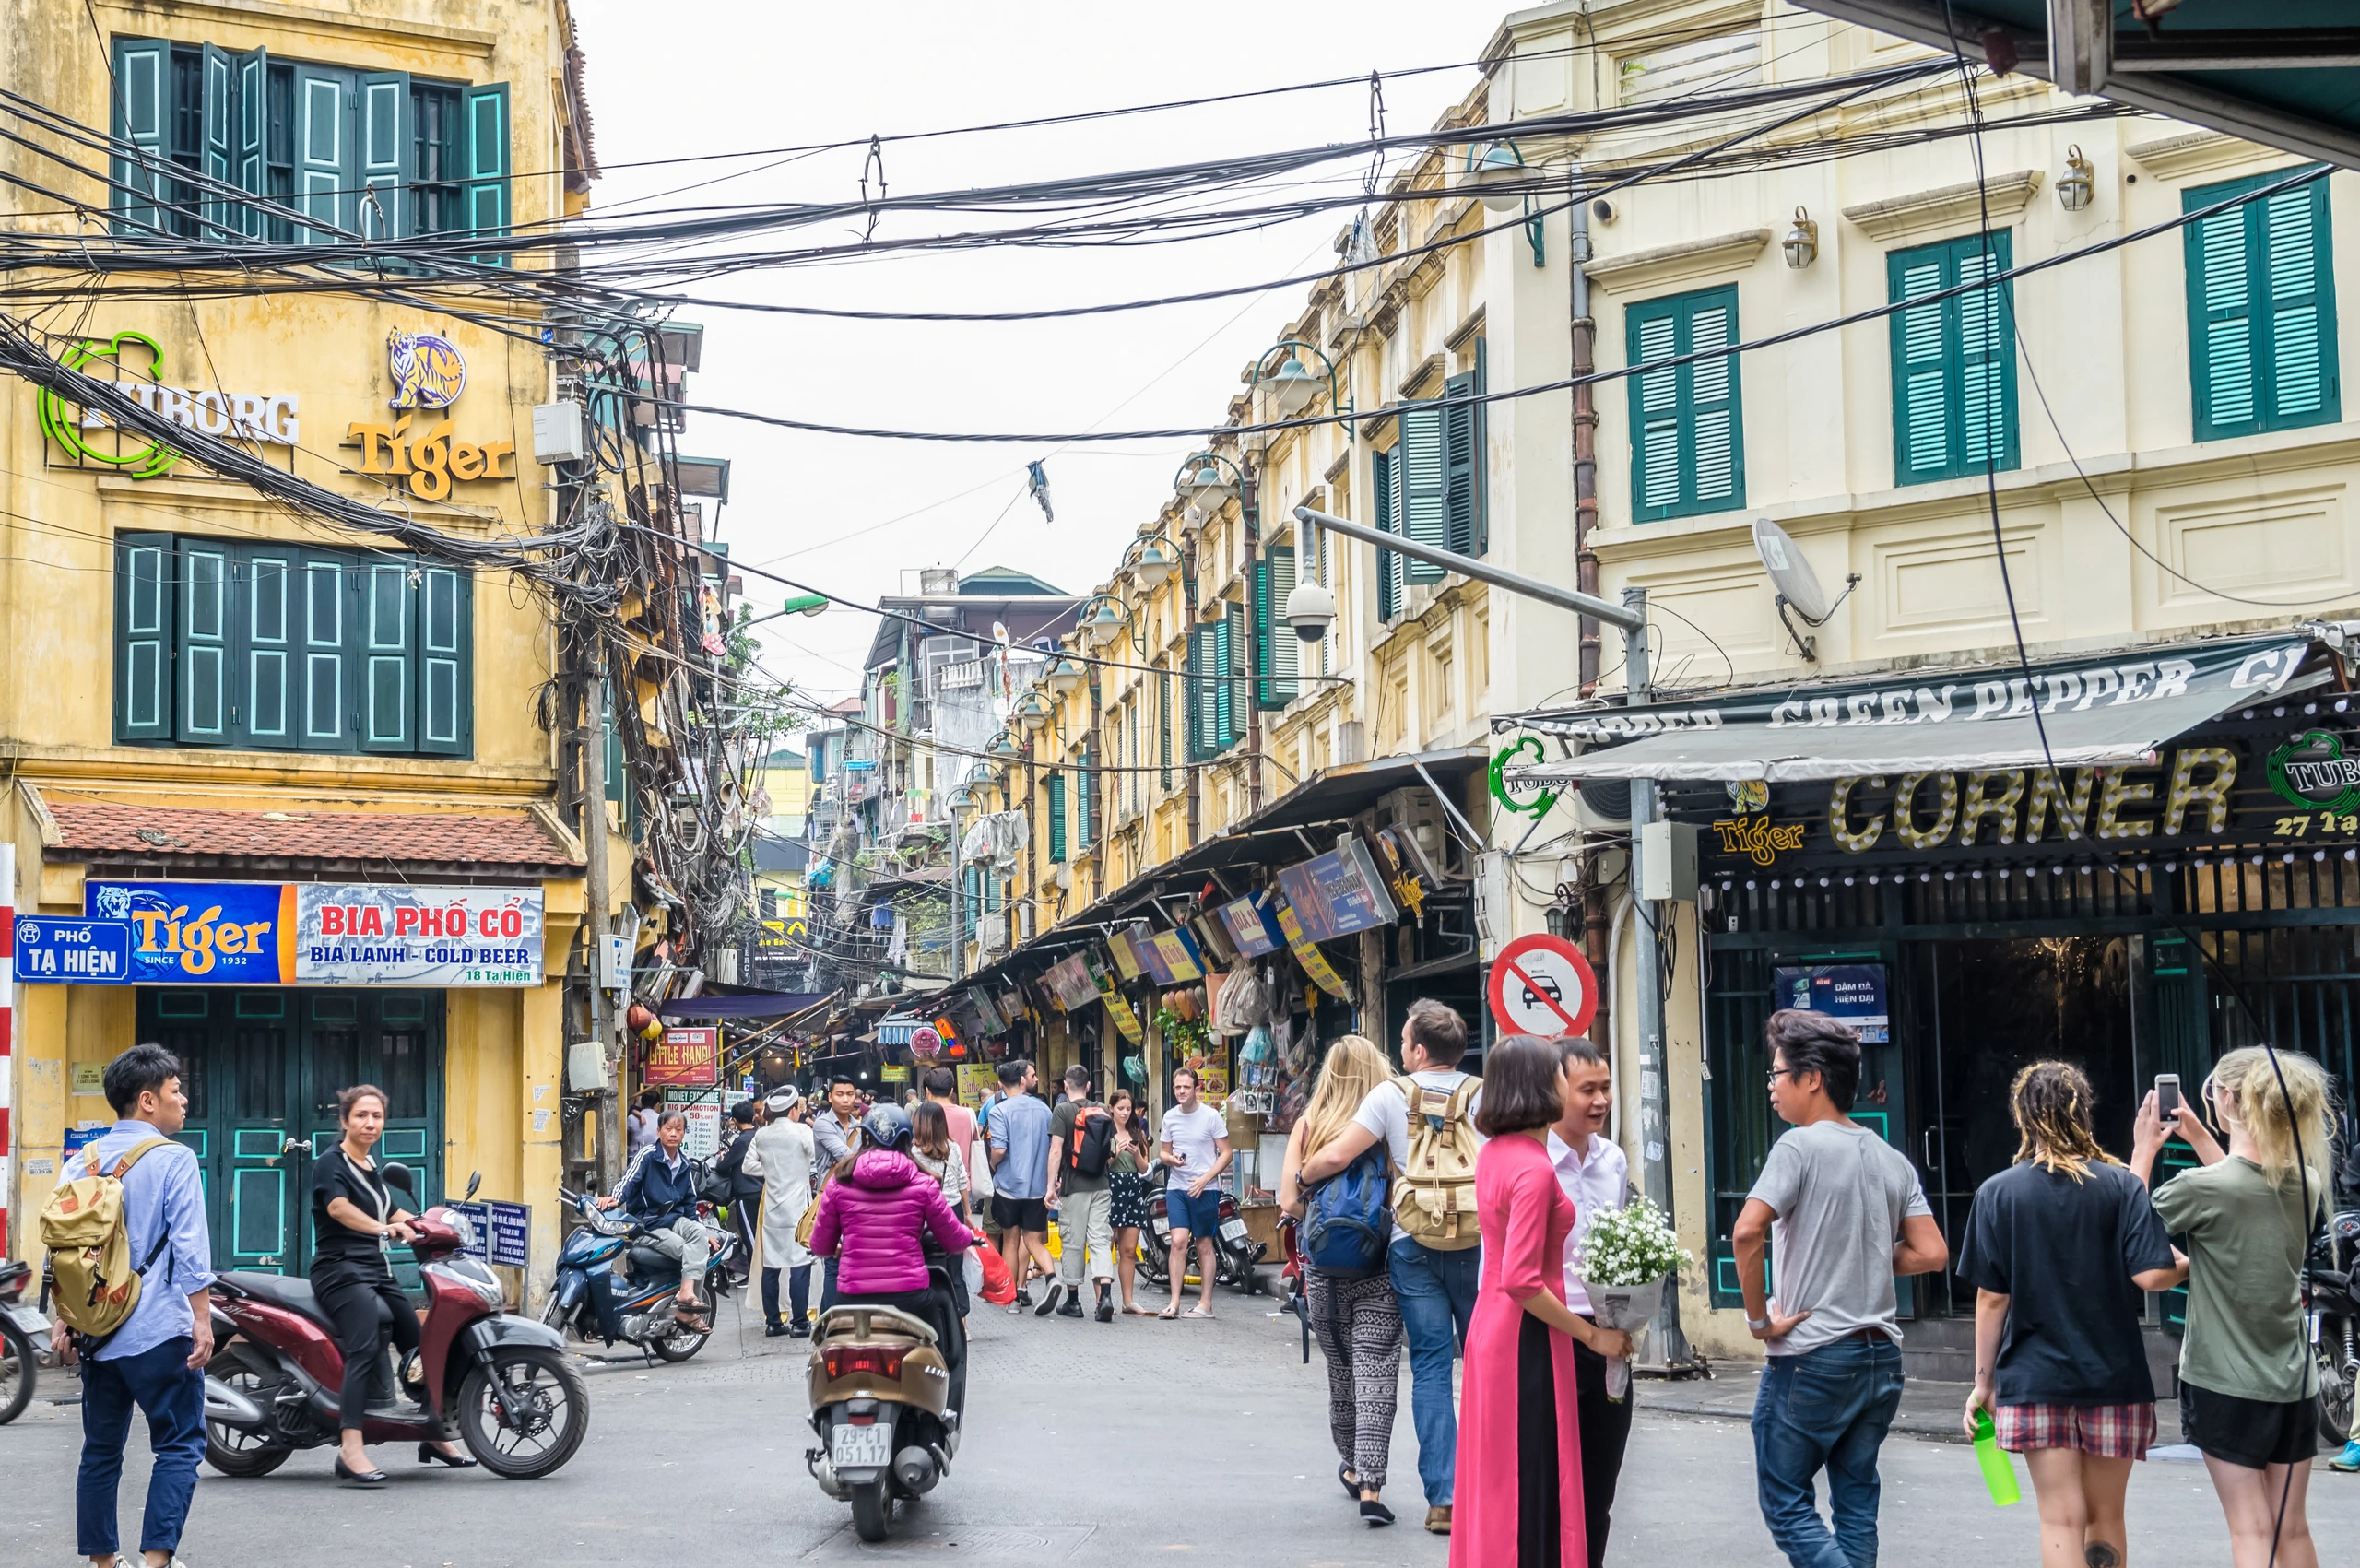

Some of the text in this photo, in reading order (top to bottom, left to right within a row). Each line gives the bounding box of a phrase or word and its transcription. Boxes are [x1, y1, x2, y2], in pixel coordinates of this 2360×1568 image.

[347, 414, 513, 501] Tiger
[1765, 685, 1957, 728] GREEN
[1964, 659, 2196, 721] PEPPER
[1829, 748, 2237, 855] CORNER
[2273, 816, 2311, 837] 27
[1712, 816, 1804, 866] Tiger
[321, 896, 523, 938] BIA PHỐ CỔ
[54, 925, 92, 943] PHỐ
[131, 904, 272, 975] Tiger
[29, 945, 117, 976] TẠ HIỆN
[145, 955, 247, 965] SINCE 1932
[310, 946, 346, 963] BIA
[350, 946, 406, 966] LẠNH
[425, 948, 474, 964] COLD
[479, 948, 530, 964] BEER
[466, 971, 481, 981] 18
[649, 1045, 679, 1065] LITTLE
[667, 1091, 689, 1101] MONEY
[841, 1428, 881, 1444] 29-C1
[835, 1445, 887, 1463] 051.17
